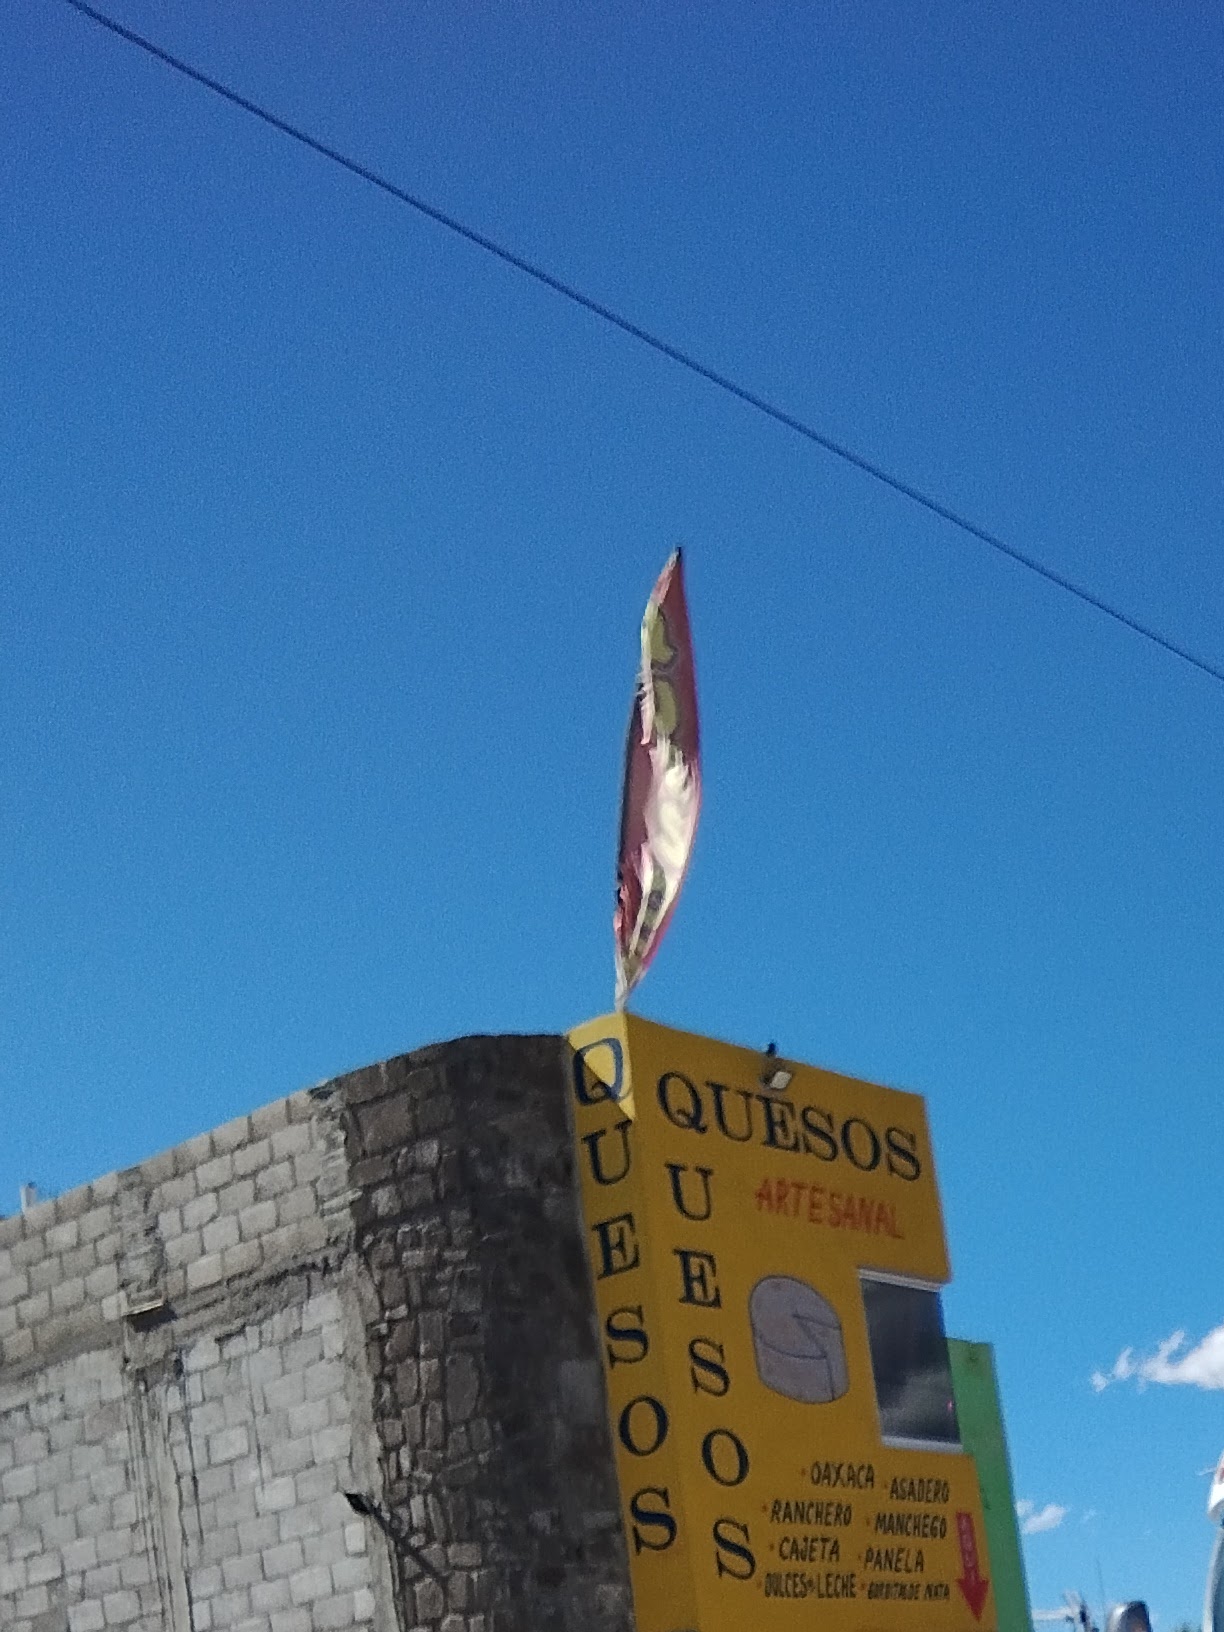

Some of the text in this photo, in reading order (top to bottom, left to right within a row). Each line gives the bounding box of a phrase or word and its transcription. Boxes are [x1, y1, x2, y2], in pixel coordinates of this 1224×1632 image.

[657, 1071, 921, 1181] QUESOS
[755, 1178, 905, 1240] ARTESANAL
[573, 1037, 677, 1555] QUESOS
[810, 1461, 875, 1489] OAXACA
[890, 1478, 950, 1503] ASADERO
[769, 1499, 852, 1527] RANCHERO
[874, 1512, 948, 1539] MANCHEGO
[778, 1536, 840, 1562] CAJETA
[864, 1548, 925, 1574] PANELA
[817, 1573, 857, 1599] LECHE
